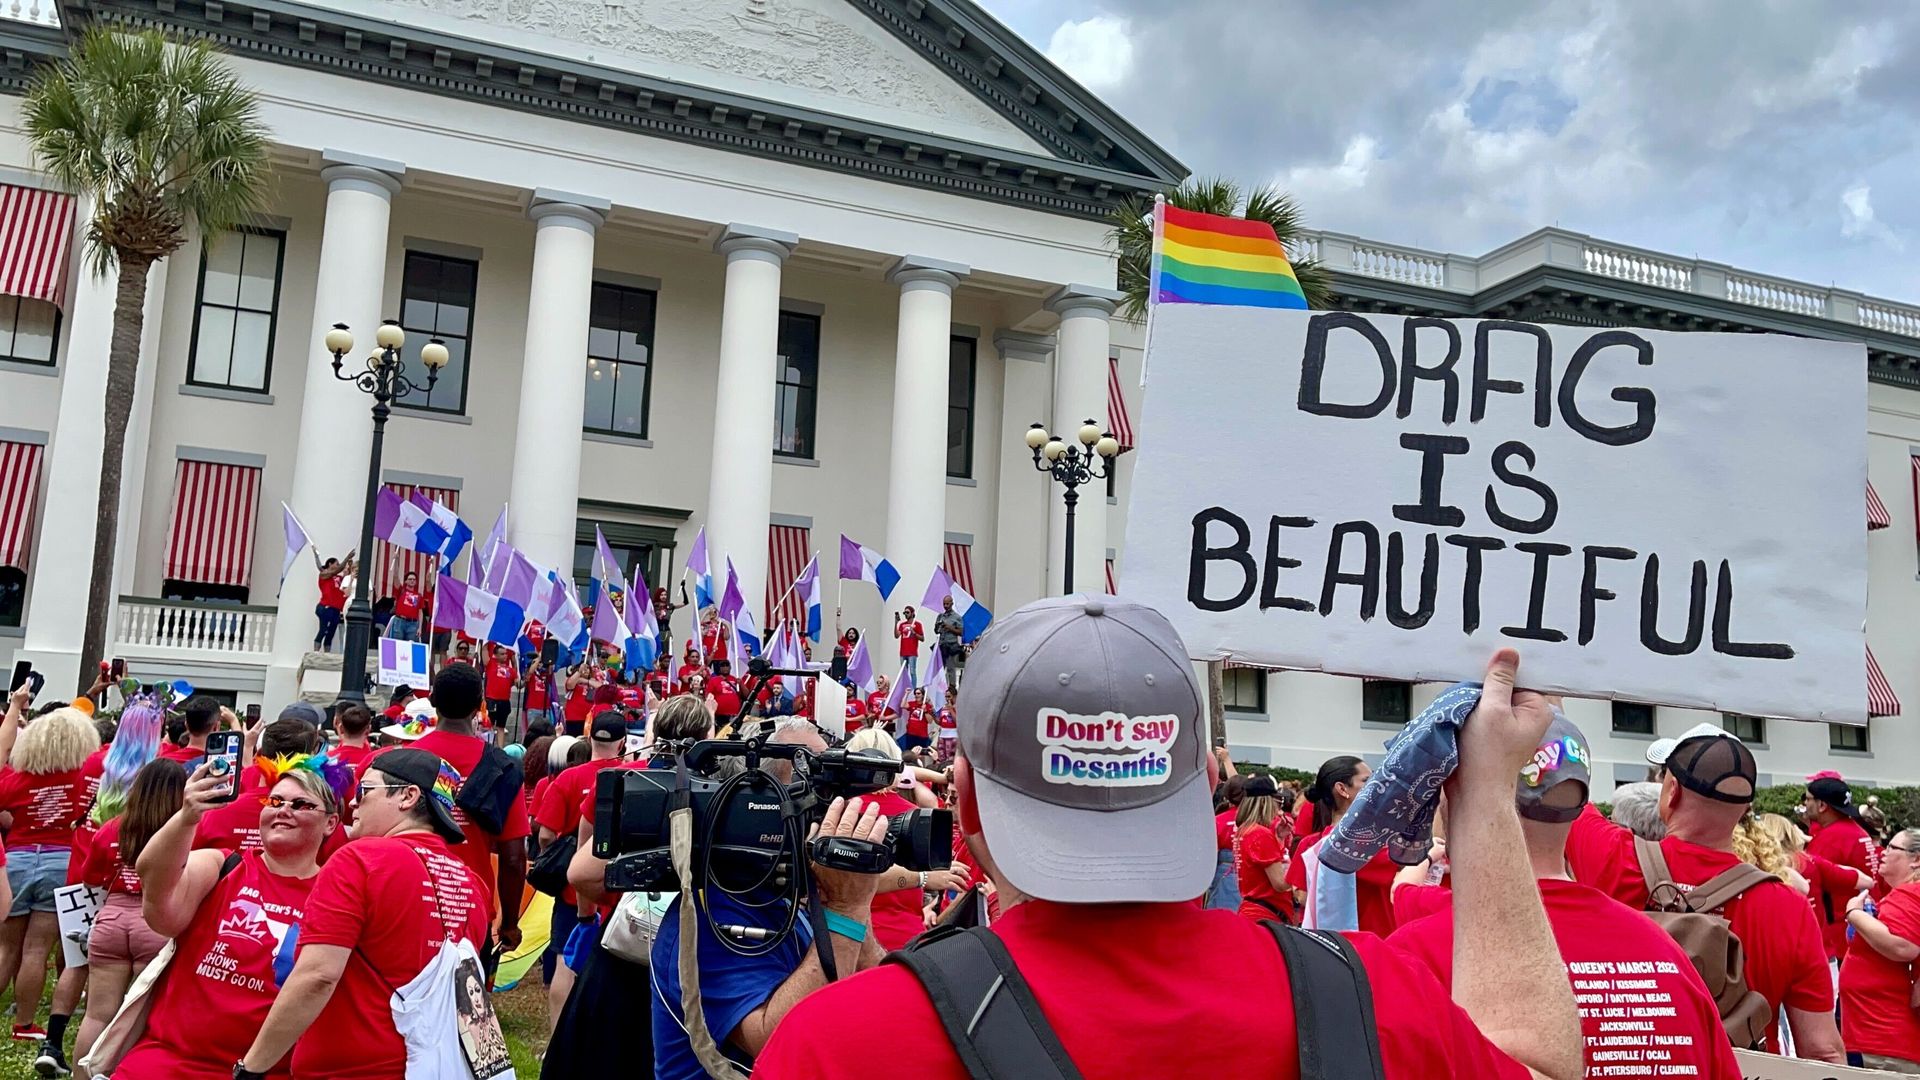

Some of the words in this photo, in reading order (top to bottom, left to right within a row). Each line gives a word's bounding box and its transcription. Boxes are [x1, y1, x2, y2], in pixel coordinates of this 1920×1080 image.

[1296, 312, 1657, 446] DRAG
[1392, 433, 1559, 534] IS
[1187, 506, 1796, 660] BEAUTIFUL
[1046, 715, 1125, 743] Don't
[1132, 719, 1174, 744] say
[1050, 752, 1167, 780] Desantis
[748, 802, 781, 811] Panason
[237, 886, 260, 898] RAG
[212, 940, 229, 955] HE
[202, 952, 239, 972] SHOWS
[1569, 961, 1616, 974] QUEEN'S
[1616, 961, 1655, 974] MARCH
[195, 963, 230, 982] MUST
[230, 973, 247, 987] GO
[247, 978, 265, 993] ON.
[1574, 979, 1610, 990] ORLANDO
[1616, 979, 1658, 989] KISSIMMEE
[1574, 994, 1603, 1004] ANFORD
[1610, 994, 1646, 1004] DAYTONA
[1646, 993, 1672, 1003] BEACH
[1578, 1008, 1589, 1018] RT
[1590, 1007, 1602, 1018] ST.
[1603, 1007, 1625, 1018] LUCIE
[1632, 1007, 1677, 1017] MELBOURNE
[1599, 1021, 1656, 1032] JACKSONVILLE
[1587, 1037, 1599, 1047] FT.
[1599, 1036, 1648, 1046] LAUDERDALE
[1654, 1035, 1675, 1046] PALM
[1592, 1050, 1639, 1061] GAINESVILLE
[1646, 1050, 1671, 1061] OCALA
[1591, 1066, 1603, 1077] ST.
[1603, 1065, 1652, 1077] PETERSBURG
